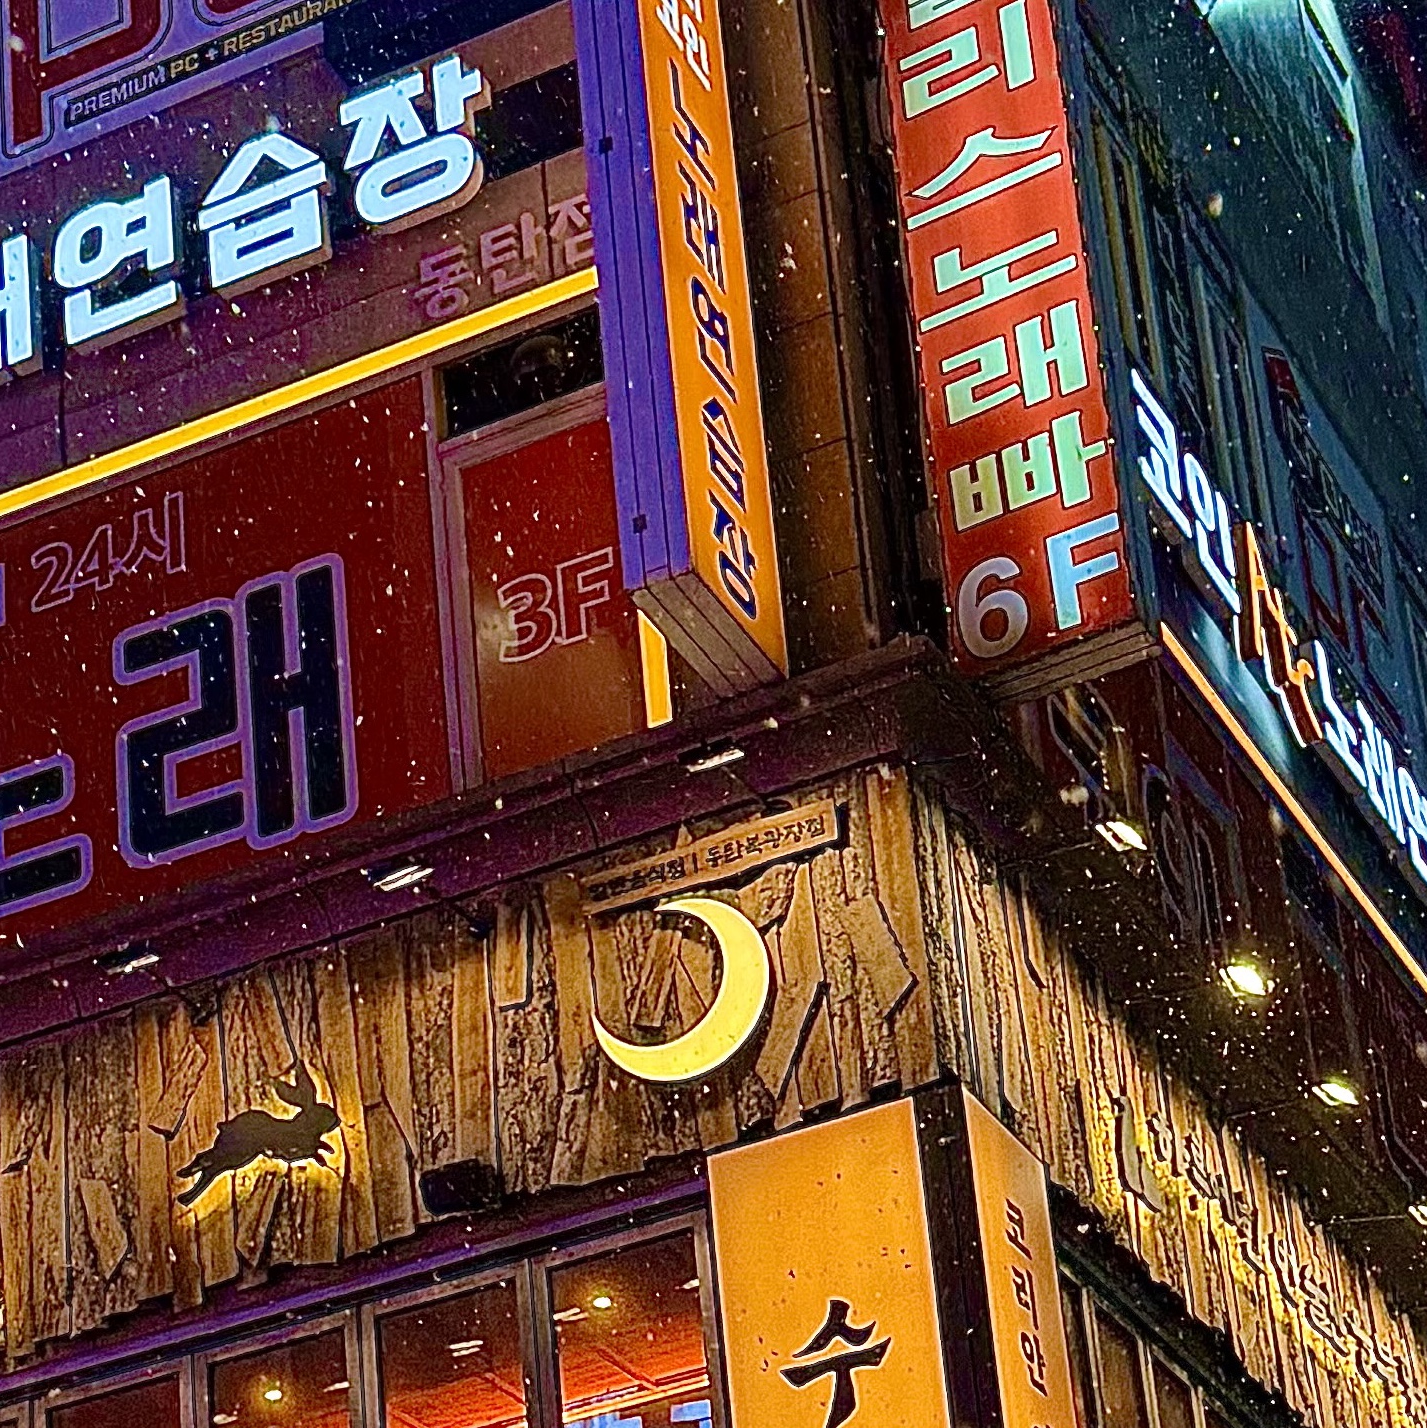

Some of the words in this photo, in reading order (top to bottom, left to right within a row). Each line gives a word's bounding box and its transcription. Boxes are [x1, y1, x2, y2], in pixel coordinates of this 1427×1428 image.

[69, 65, 166, 121] PREMIUM
[170, 48, 199, 79] PC
[31, 491, 187, 614] 24시
[498, 546, 615, 665] 3F
[956, 512, 1121, 658] 6F
